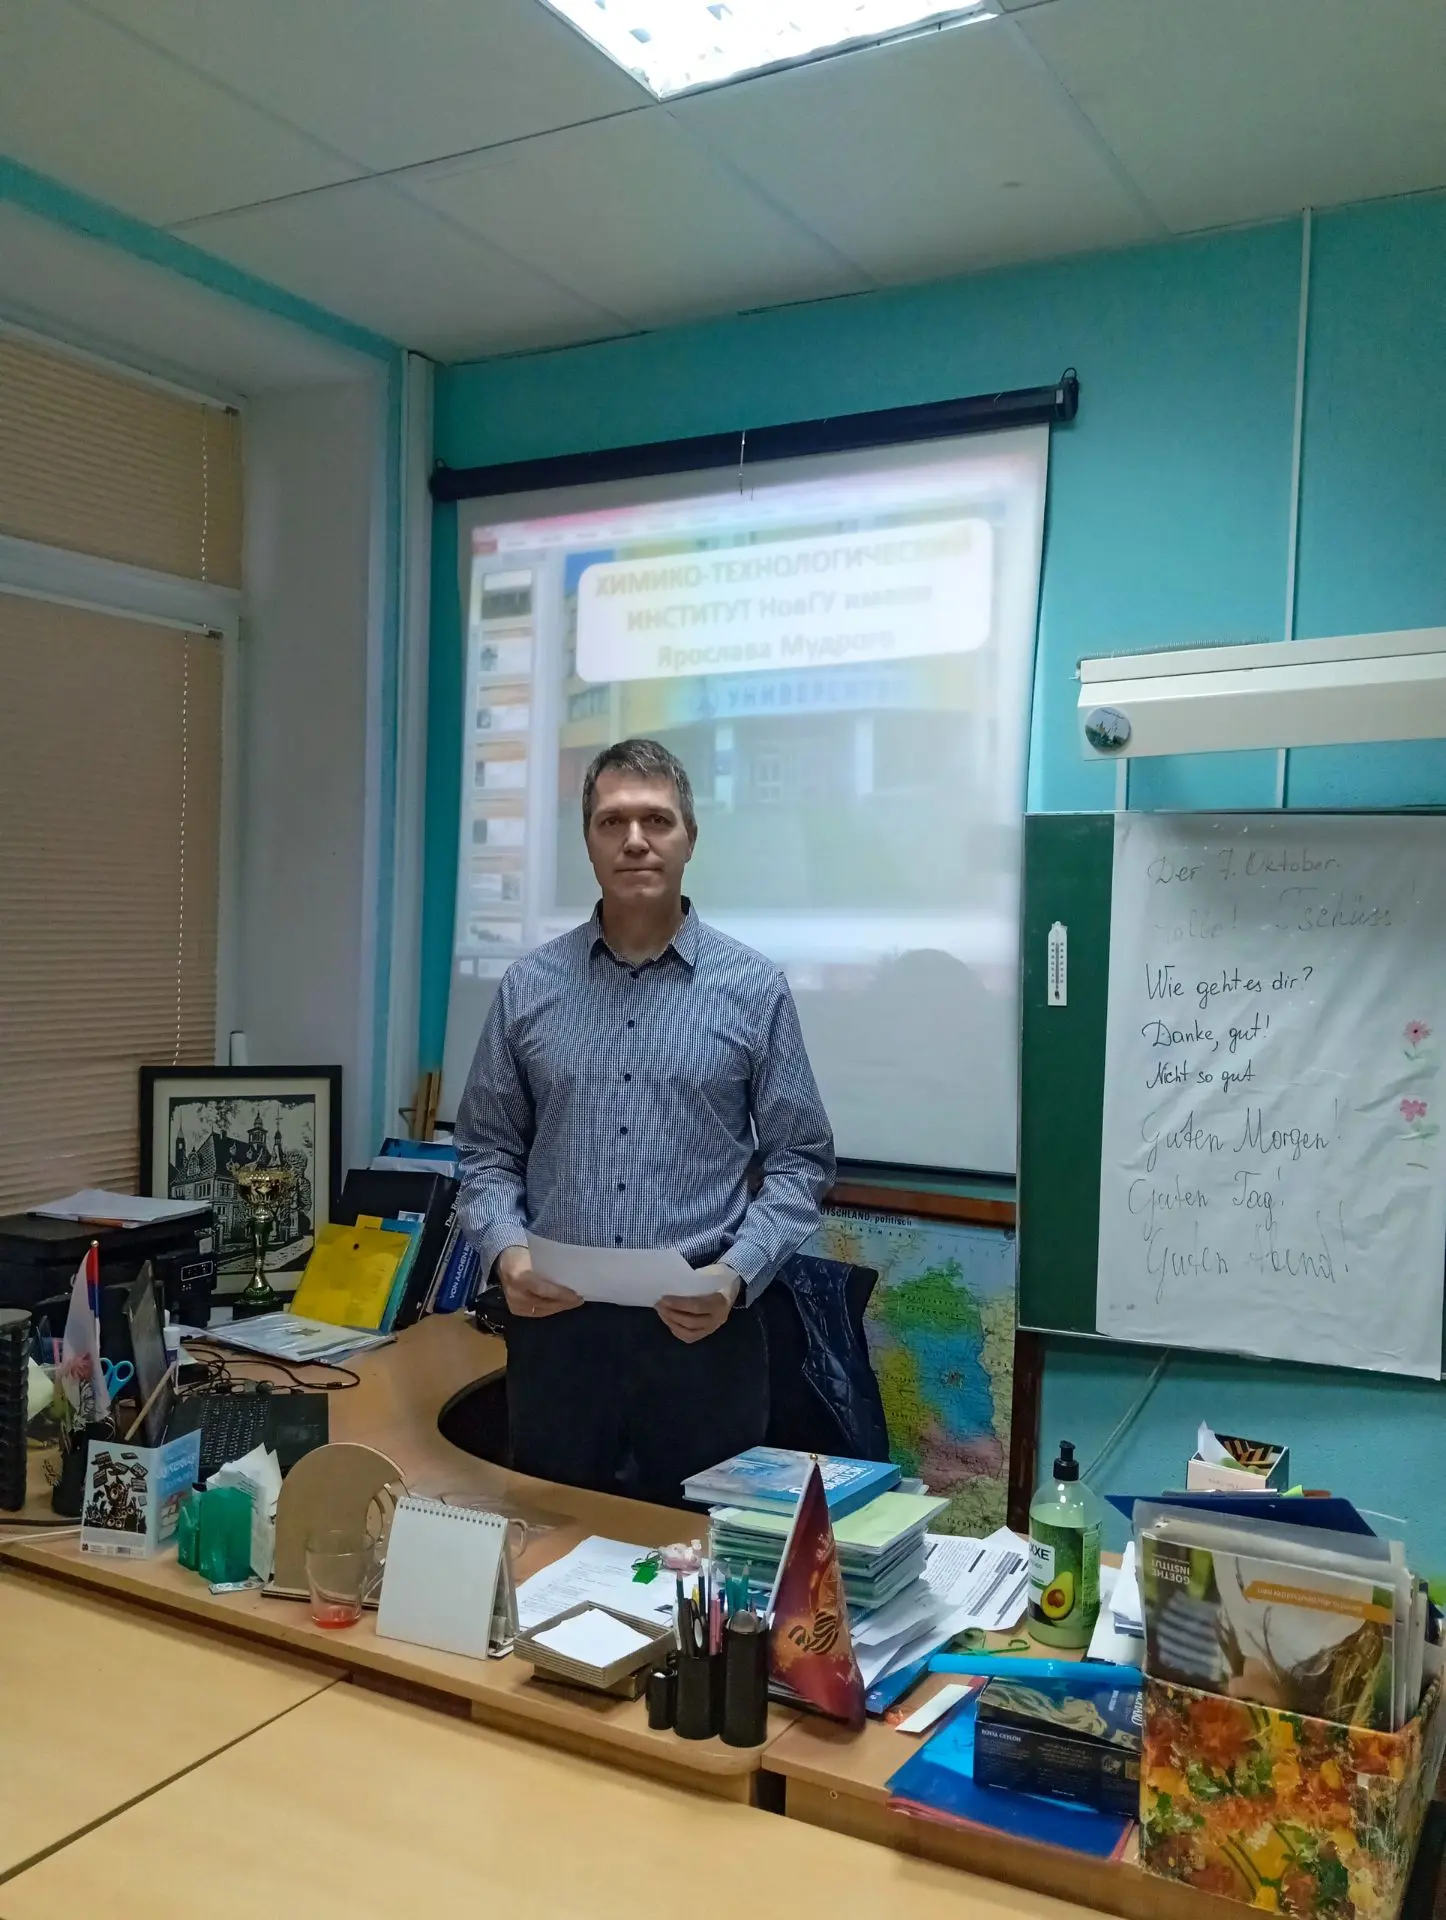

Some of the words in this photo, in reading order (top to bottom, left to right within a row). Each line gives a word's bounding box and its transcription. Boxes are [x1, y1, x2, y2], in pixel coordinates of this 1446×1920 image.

[626, 598, 752, 632] ИНСТИТУТ
[1147, 856, 1202, 885] Der
[1146, 963, 1185, 1000] Wie
[1272, 966, 1313, 992] dir?
[1141, 1019, 1219, 1052] Danke,
[1229, 1012, 1270, 1053] gut!
[1146, 1060, 1189, 1089] Nicht
[1196, 1070, 1213, 1084] so
[1221, 1059, 1256, 1093] gut
[1141, 1110, 1224, 1173] Guten
[1128, 1174, 1209, 1242] Guten
[1147, 1221, 1229, 1305] Guten
[1152, 1559, 1190, 1575] INSTITUT
